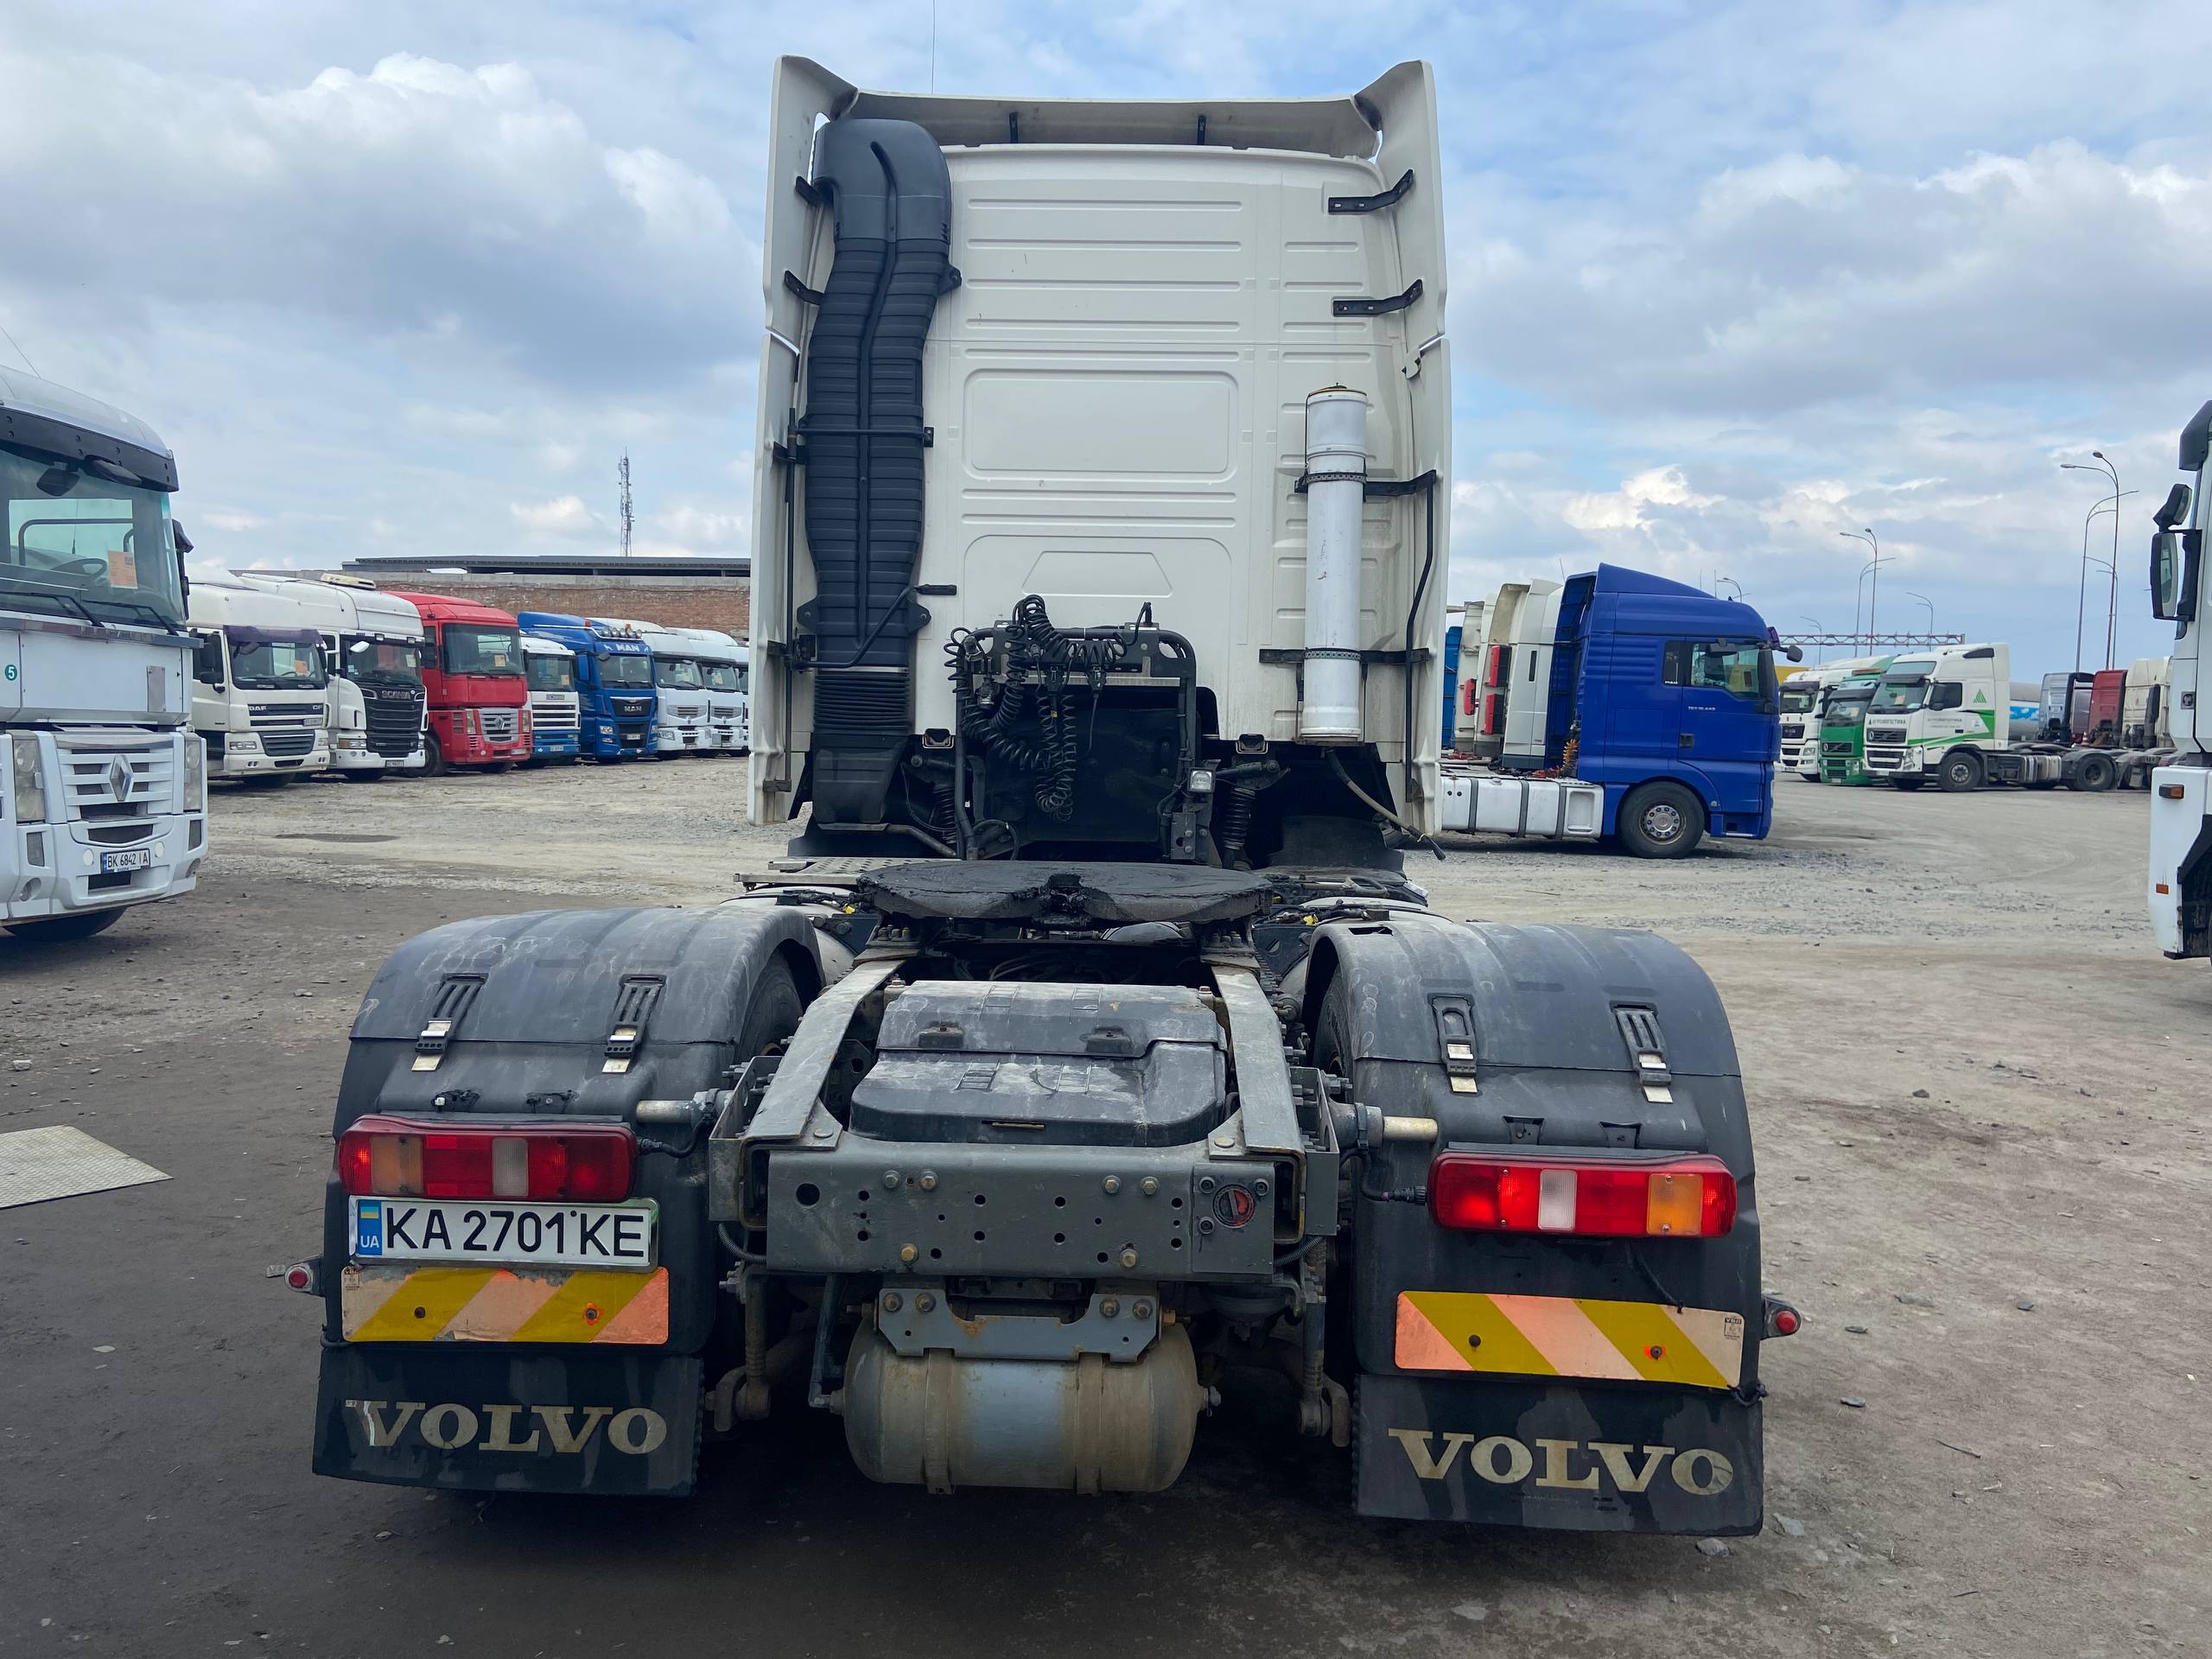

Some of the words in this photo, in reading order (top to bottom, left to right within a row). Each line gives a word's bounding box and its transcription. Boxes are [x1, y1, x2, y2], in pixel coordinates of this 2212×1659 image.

[616, 644, 639, 652] MAN
[8, 665, 15, 679] 5
[381, 690, 411, 700] SCANIA
[107, 855, 118, 868] BK
[120, 853, 137, 866] 6842
[386, 1207, 452, 1250] KA
[463, 1210, 565, 1255] 2701
[580, 1212, 645, 1258] KE
[359, 1235, 380, 1249] UA
[346, 1399, 668, 1455] VOLVO
[1388, 1427, 1734, 1497] VOLVO
